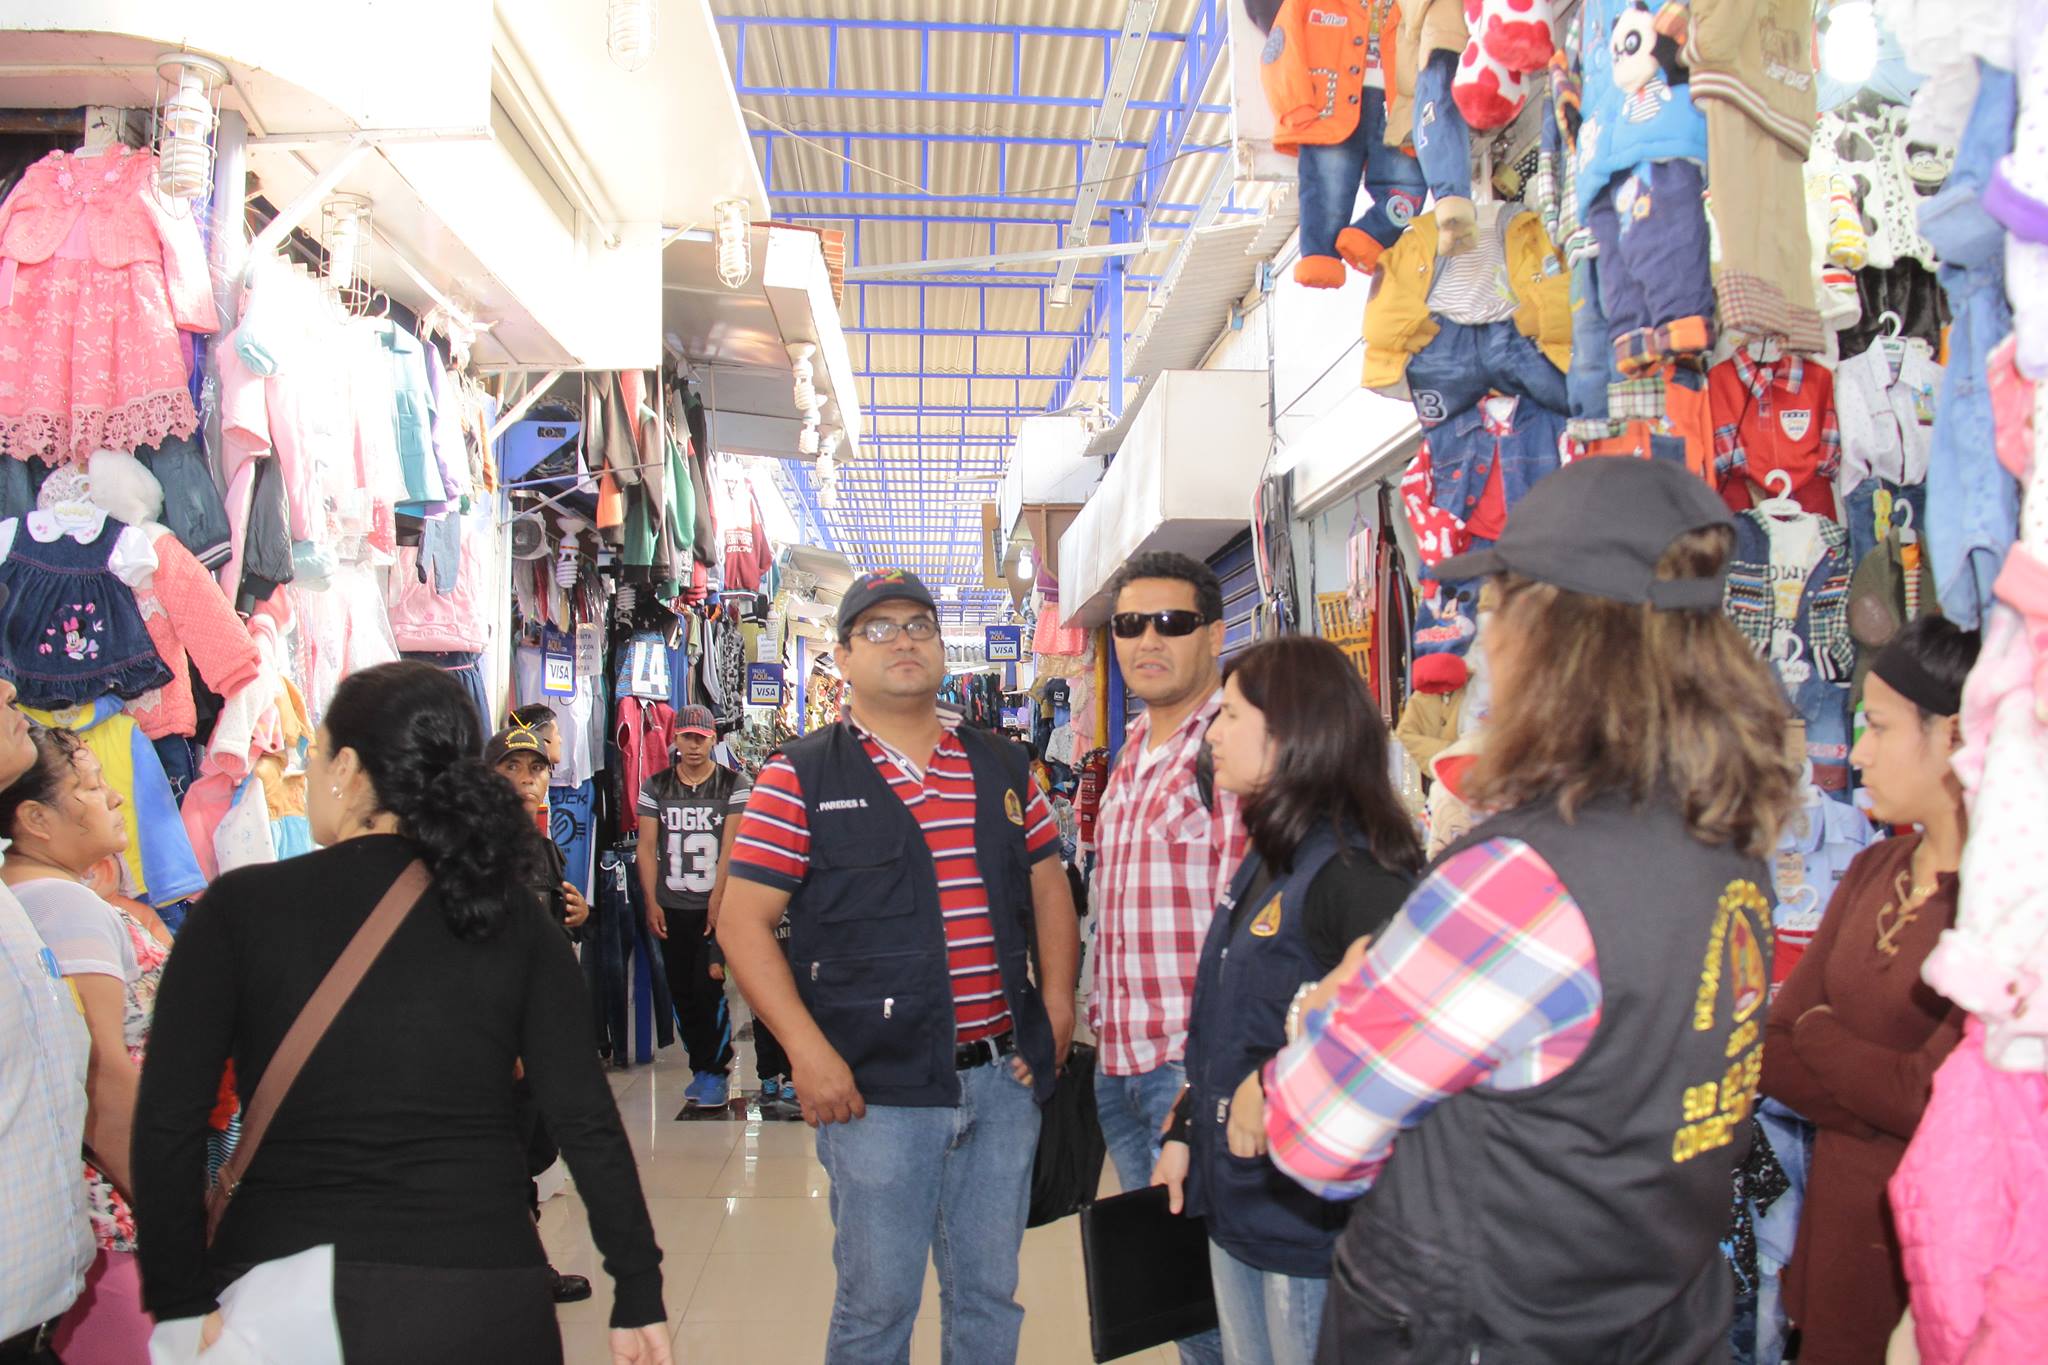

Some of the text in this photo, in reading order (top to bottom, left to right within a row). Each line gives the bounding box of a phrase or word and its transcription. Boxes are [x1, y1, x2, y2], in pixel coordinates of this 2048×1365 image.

[994, 646, 1014, 654] VISA
[549, 663, 569, 680] VISA
[756, 687, 776, 697] VISA
[819, 799, 859, 811] PAREDES
[666, 806, 714, 831] DGK
[665, 832, 719, 893] 13
